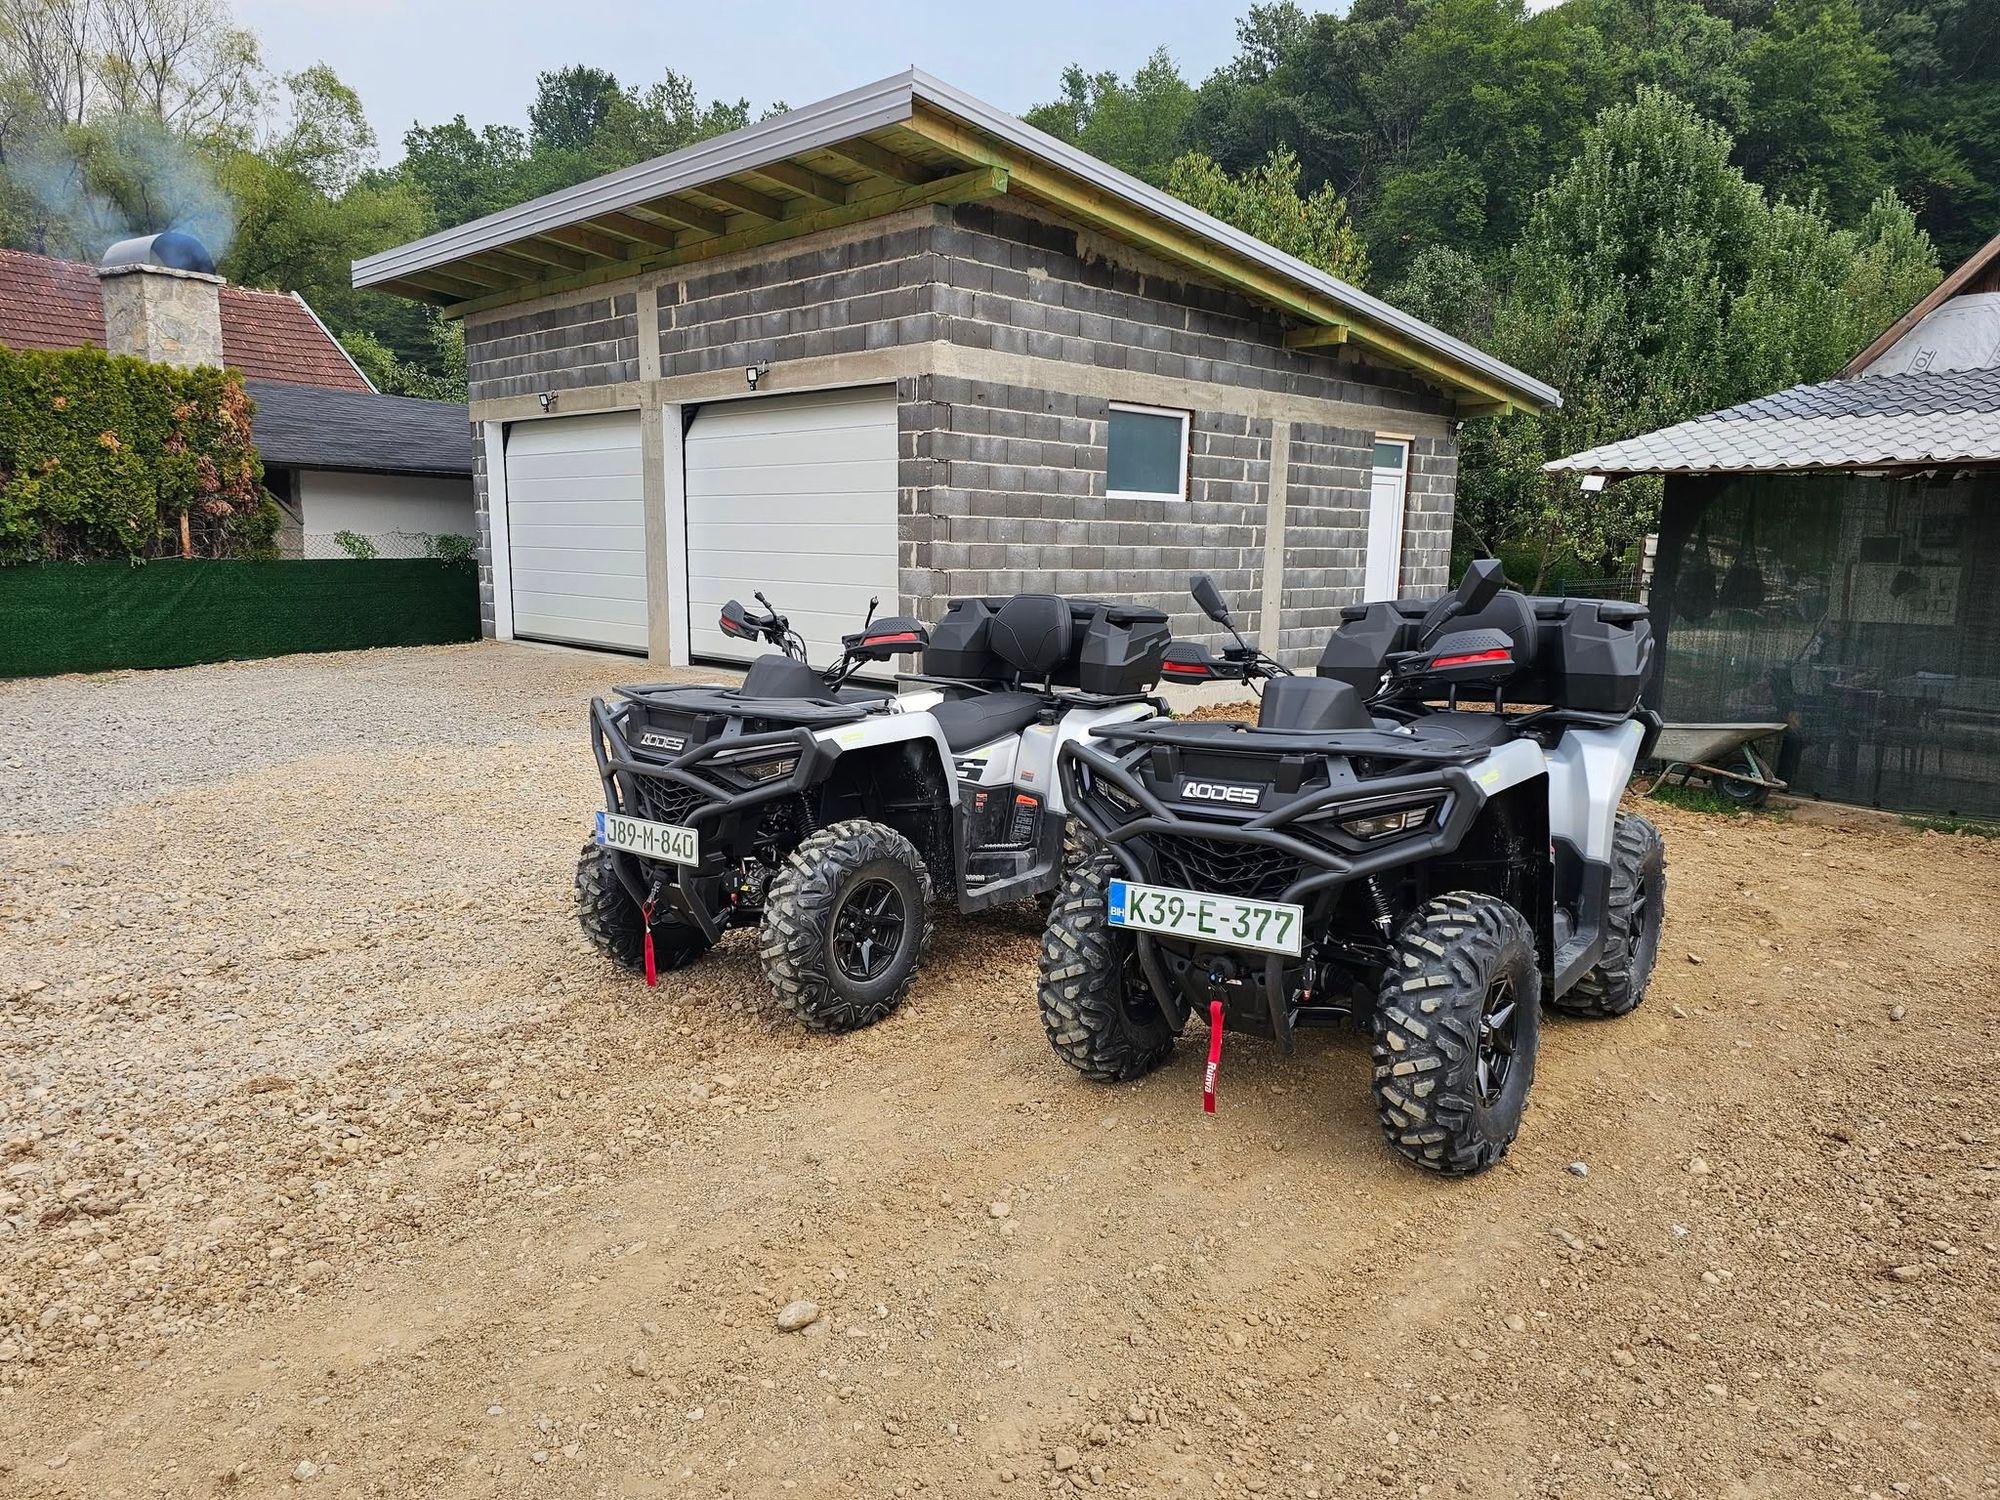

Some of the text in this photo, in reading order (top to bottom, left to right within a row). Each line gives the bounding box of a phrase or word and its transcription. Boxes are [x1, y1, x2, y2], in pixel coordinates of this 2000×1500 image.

[640, 733, 685, 751] AODES
[1181, 782, 1260, 804] AODES
[607, 818, 694, 859] J89-M-840
[1110, 906, 1125, 917] BIH
[1129, 890, 1294, 945] K39-E-377
